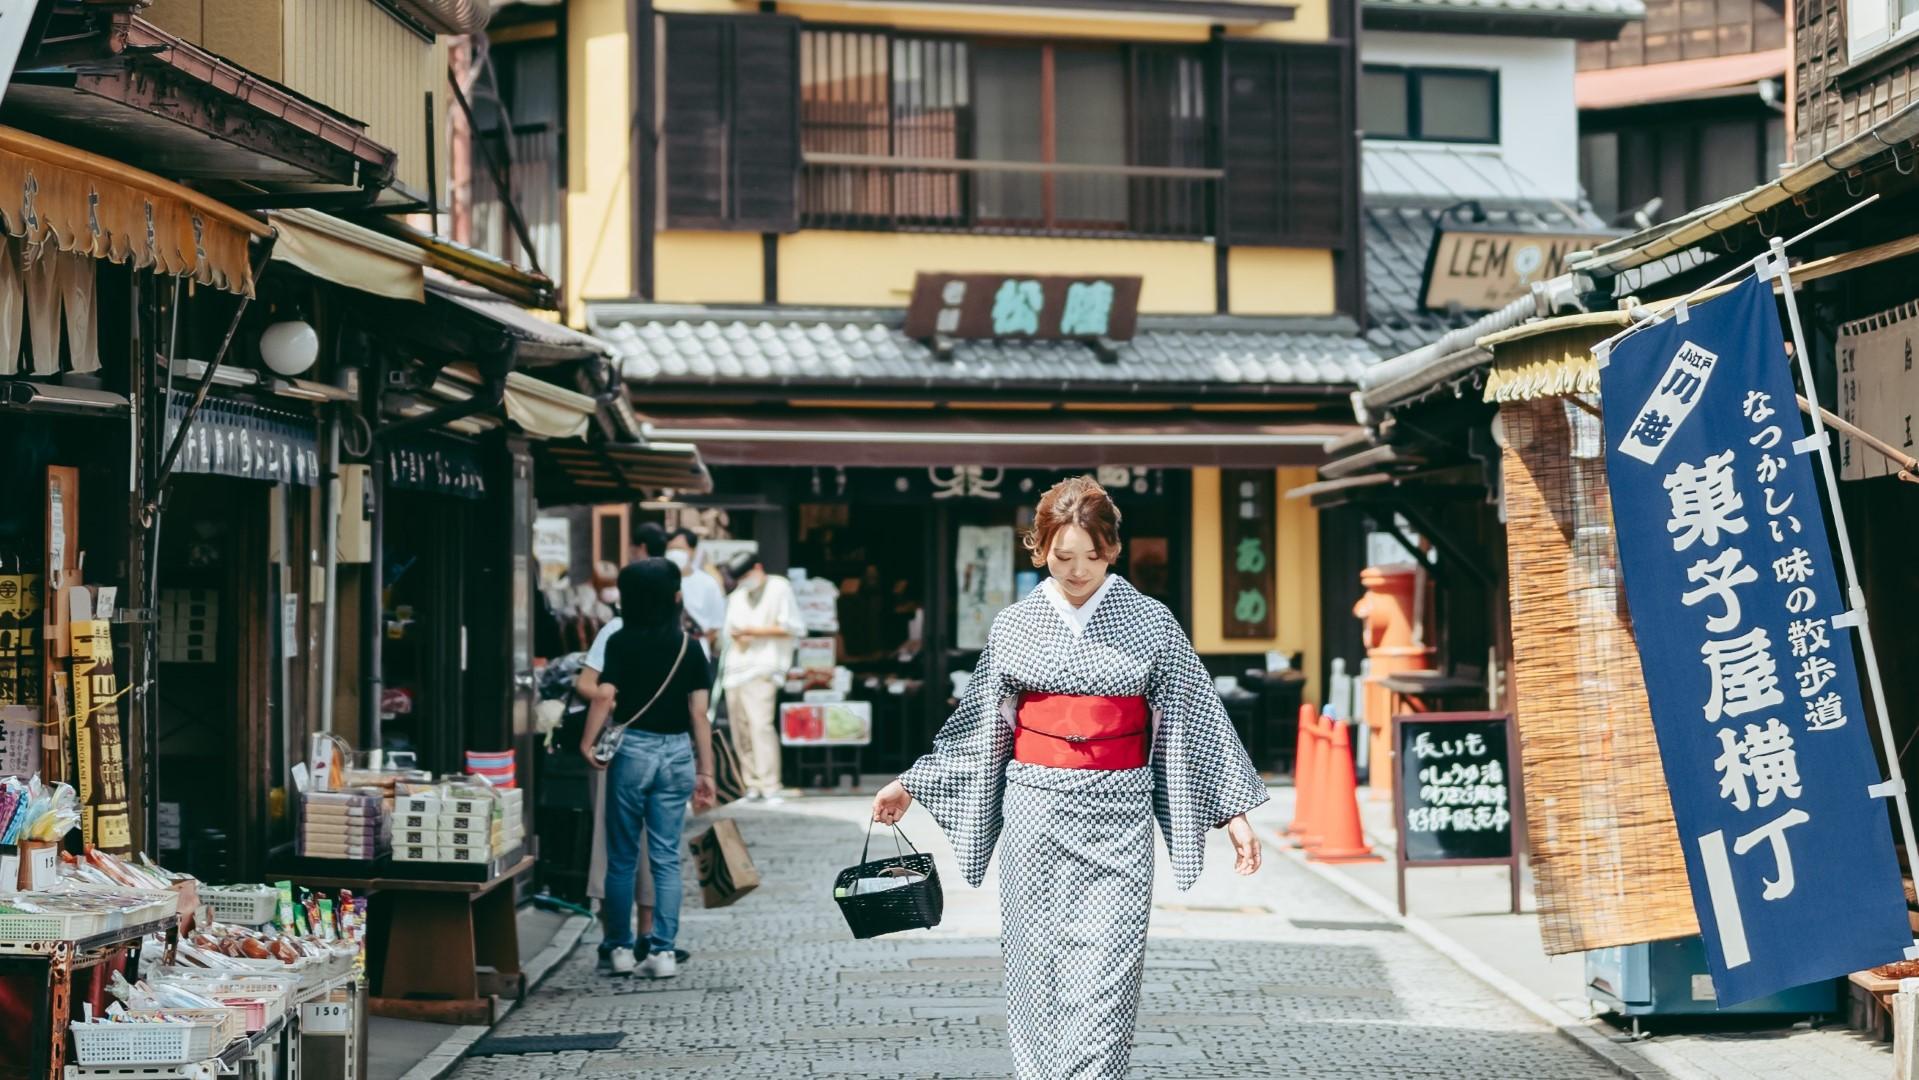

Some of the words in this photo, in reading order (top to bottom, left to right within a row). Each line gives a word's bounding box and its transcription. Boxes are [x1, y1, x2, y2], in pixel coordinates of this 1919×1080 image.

[1679, 348, 1714, 370] 小江戸
[1631, 368, 1702, 447] 川越
[1235, 537, 1267, 624] あめ
[1743, 390, 1847, 731] なつかしい味の散歩道
[1662, 448, 1810, 902] 菓子屋横丁
[1412, 732, 1487, 759] 長いも
